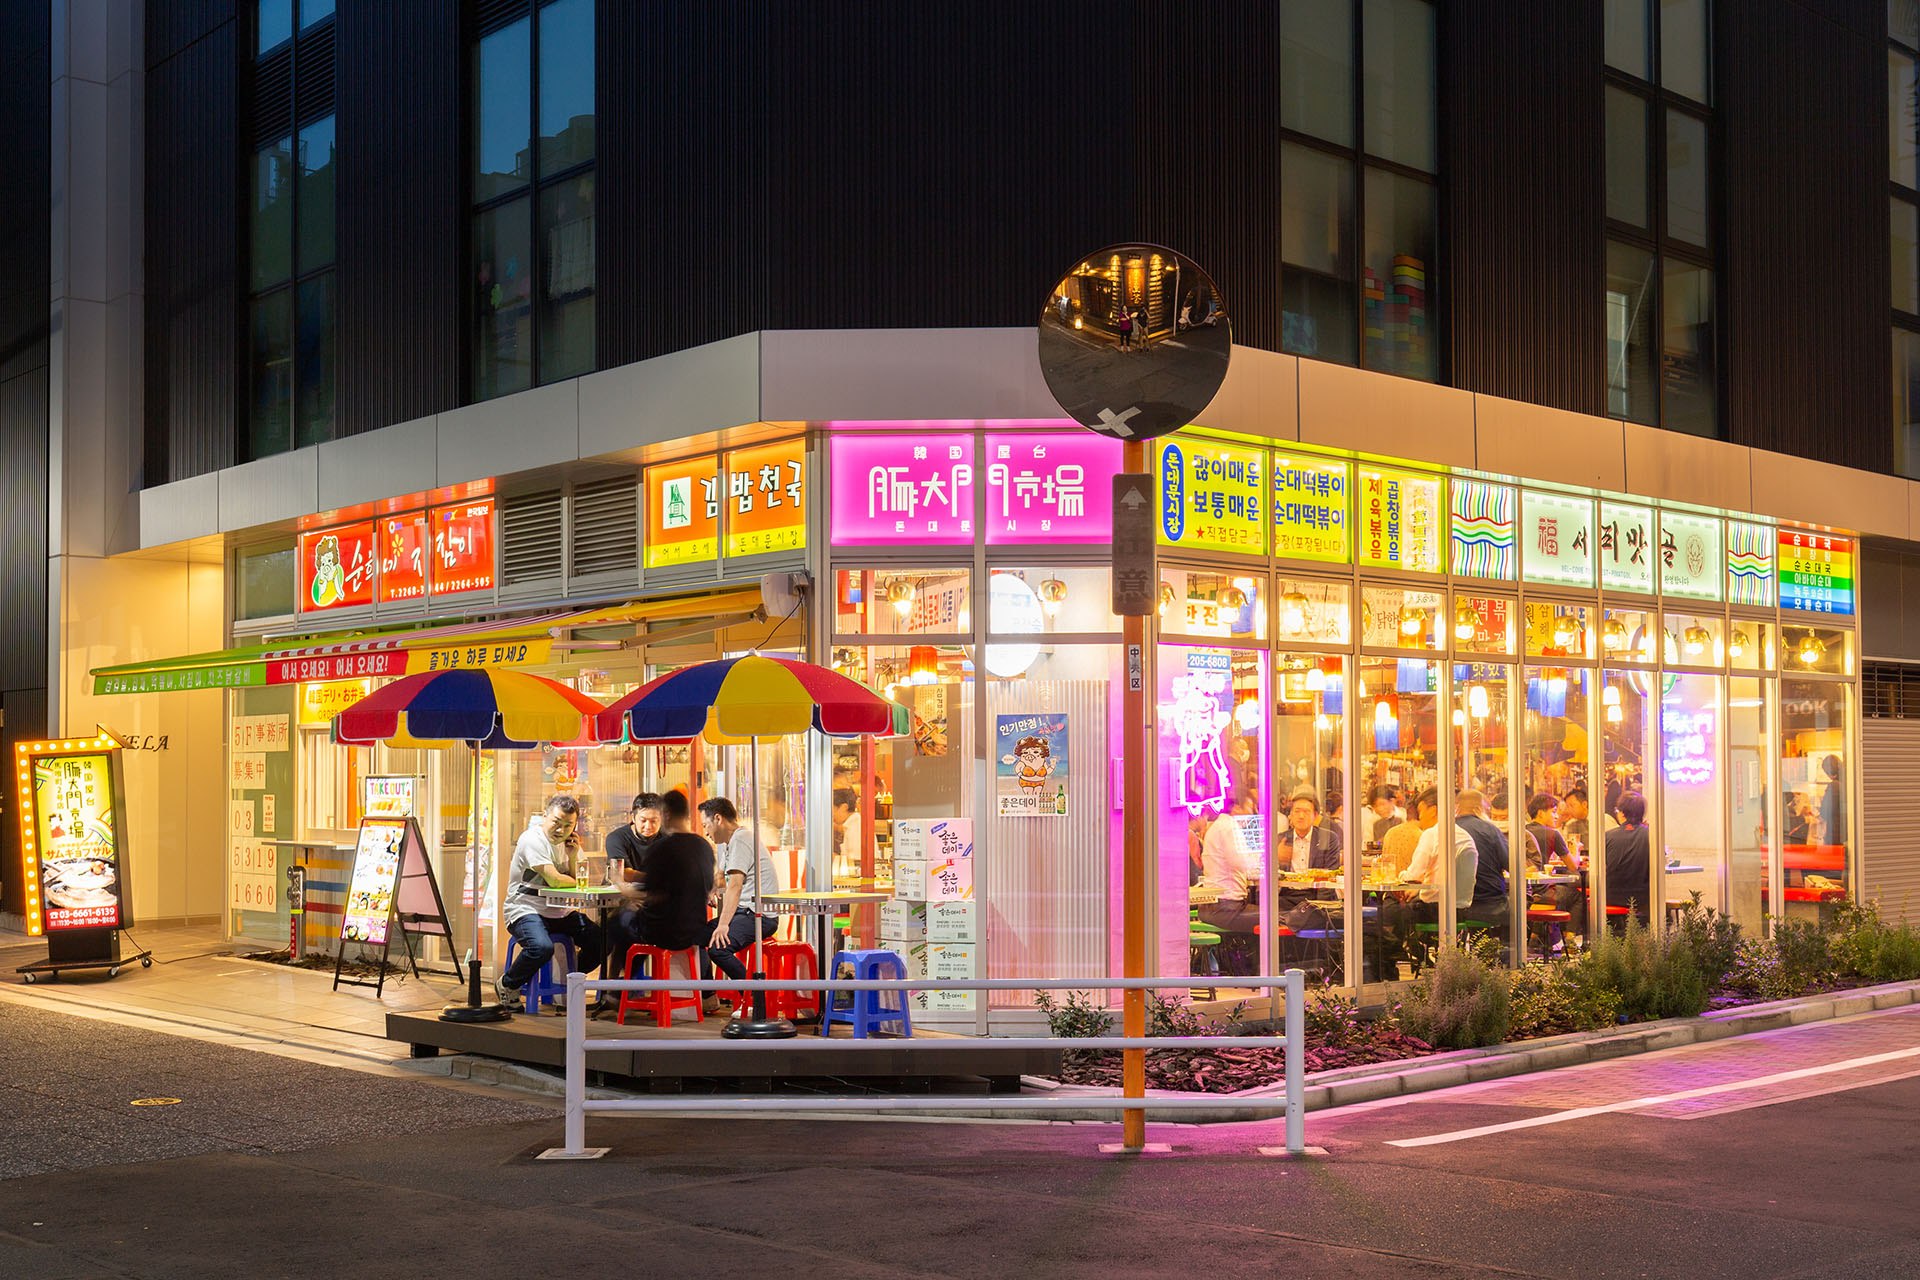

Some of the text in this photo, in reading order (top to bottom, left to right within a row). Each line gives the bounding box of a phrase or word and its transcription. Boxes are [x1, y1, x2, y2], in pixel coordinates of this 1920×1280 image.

[699, 460, 802, 519] 김밥천국
[1194, 491, 1261, 522] 보통매운
[895, 520, 1052, 533] 돈대문시장
[429, 650, 460, 671] 즐거운
[466, 647, 487, 666] 하루
[1129, 647, 1141, 689] 中央区
[122, 735, 169, 752] ELA
[233, 760, 266, 782] 募集中
[369, 781, 406, 796] TAKE OUT
[234, 810, 252, 830] 03
[234, 845, 275, 867] 5319
[234, 883, 275, 905] 1660
[59, 907, 116, 919] 03-6661-6139
